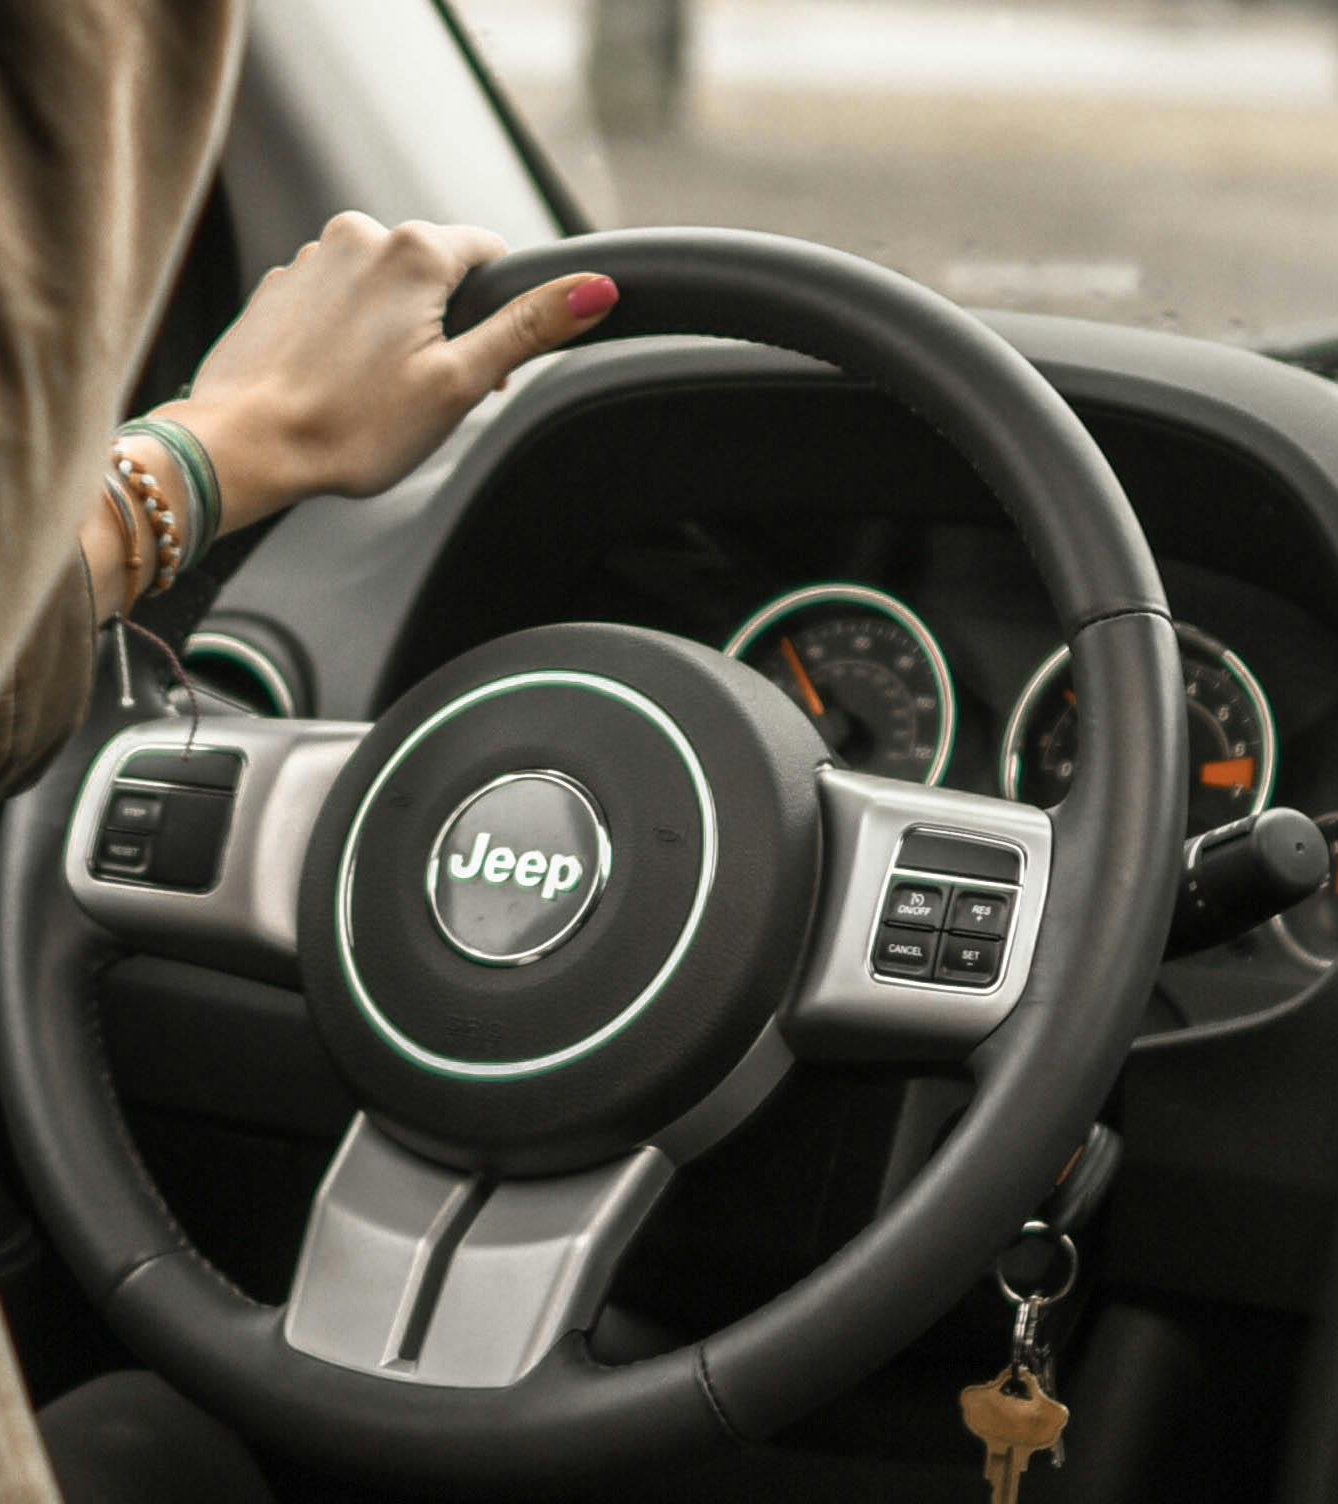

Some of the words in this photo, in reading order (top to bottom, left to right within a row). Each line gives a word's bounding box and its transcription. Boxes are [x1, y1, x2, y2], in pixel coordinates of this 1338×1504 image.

[1235, 742, 1246, 757] 6
[448, 831, 583, 900] Jeep
[897, 904, 933, 917] ON/OFF
[971, 904, 992, 917] RES
[888, 943, 923, 958] CANCEL
[961, 949, 981, 961] SET
